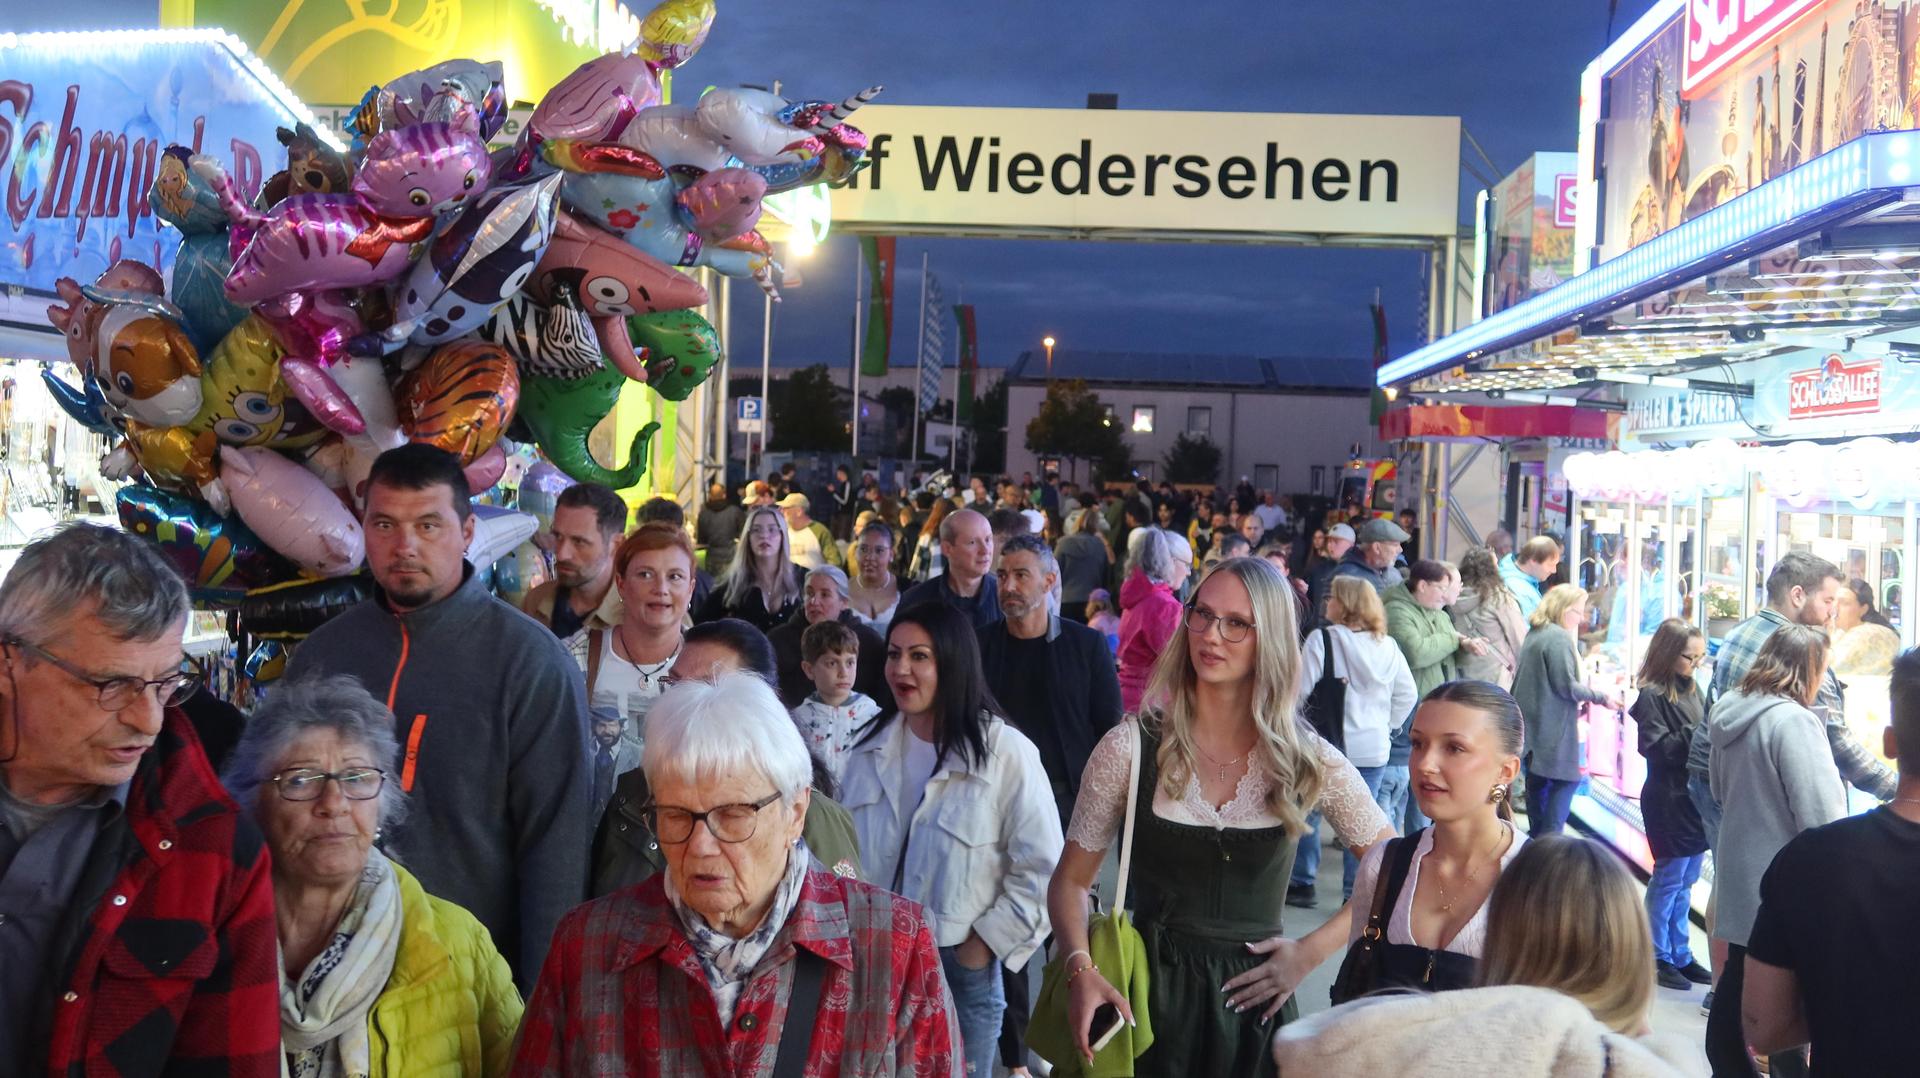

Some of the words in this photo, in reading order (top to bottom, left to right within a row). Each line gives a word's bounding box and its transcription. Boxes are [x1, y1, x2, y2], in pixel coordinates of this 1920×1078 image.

[913, 134, 1399, 203] Wiedersehen
[743, 400, 758, 418] P
[1791, 370, 1880, 409] SCHLOSSALLEE
